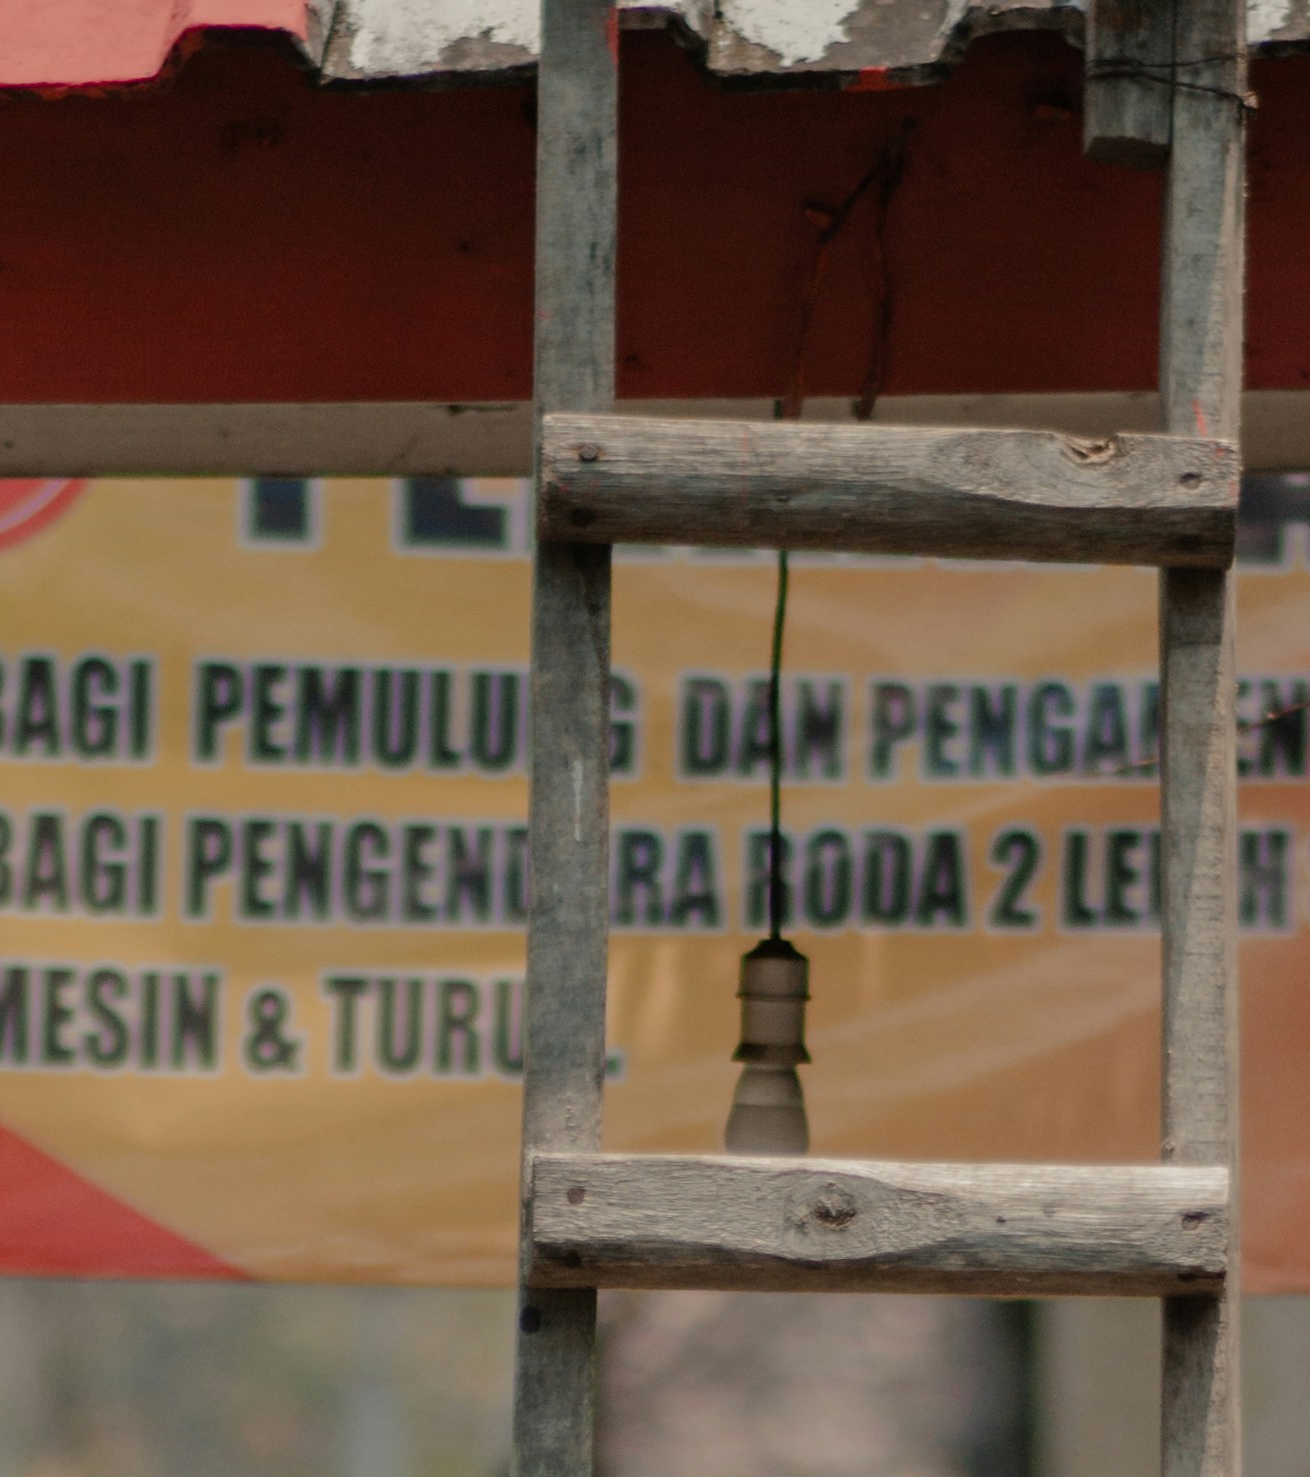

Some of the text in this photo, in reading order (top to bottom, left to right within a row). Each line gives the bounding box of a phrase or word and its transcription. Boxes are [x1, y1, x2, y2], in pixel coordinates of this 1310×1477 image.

[195, 660, 638, 777] PEMULUG
[681, 674, 844, 779] DAN
[186, 816, 722, 929] PENGENDRA
[746, 828, 968, 930] RODA
[990, 828, 1041, 929] 2
[1062, 828, 1291, 930] LEH
[243, 987, 302, 1074] &
[322, 974, 627, 1081] TURU.
